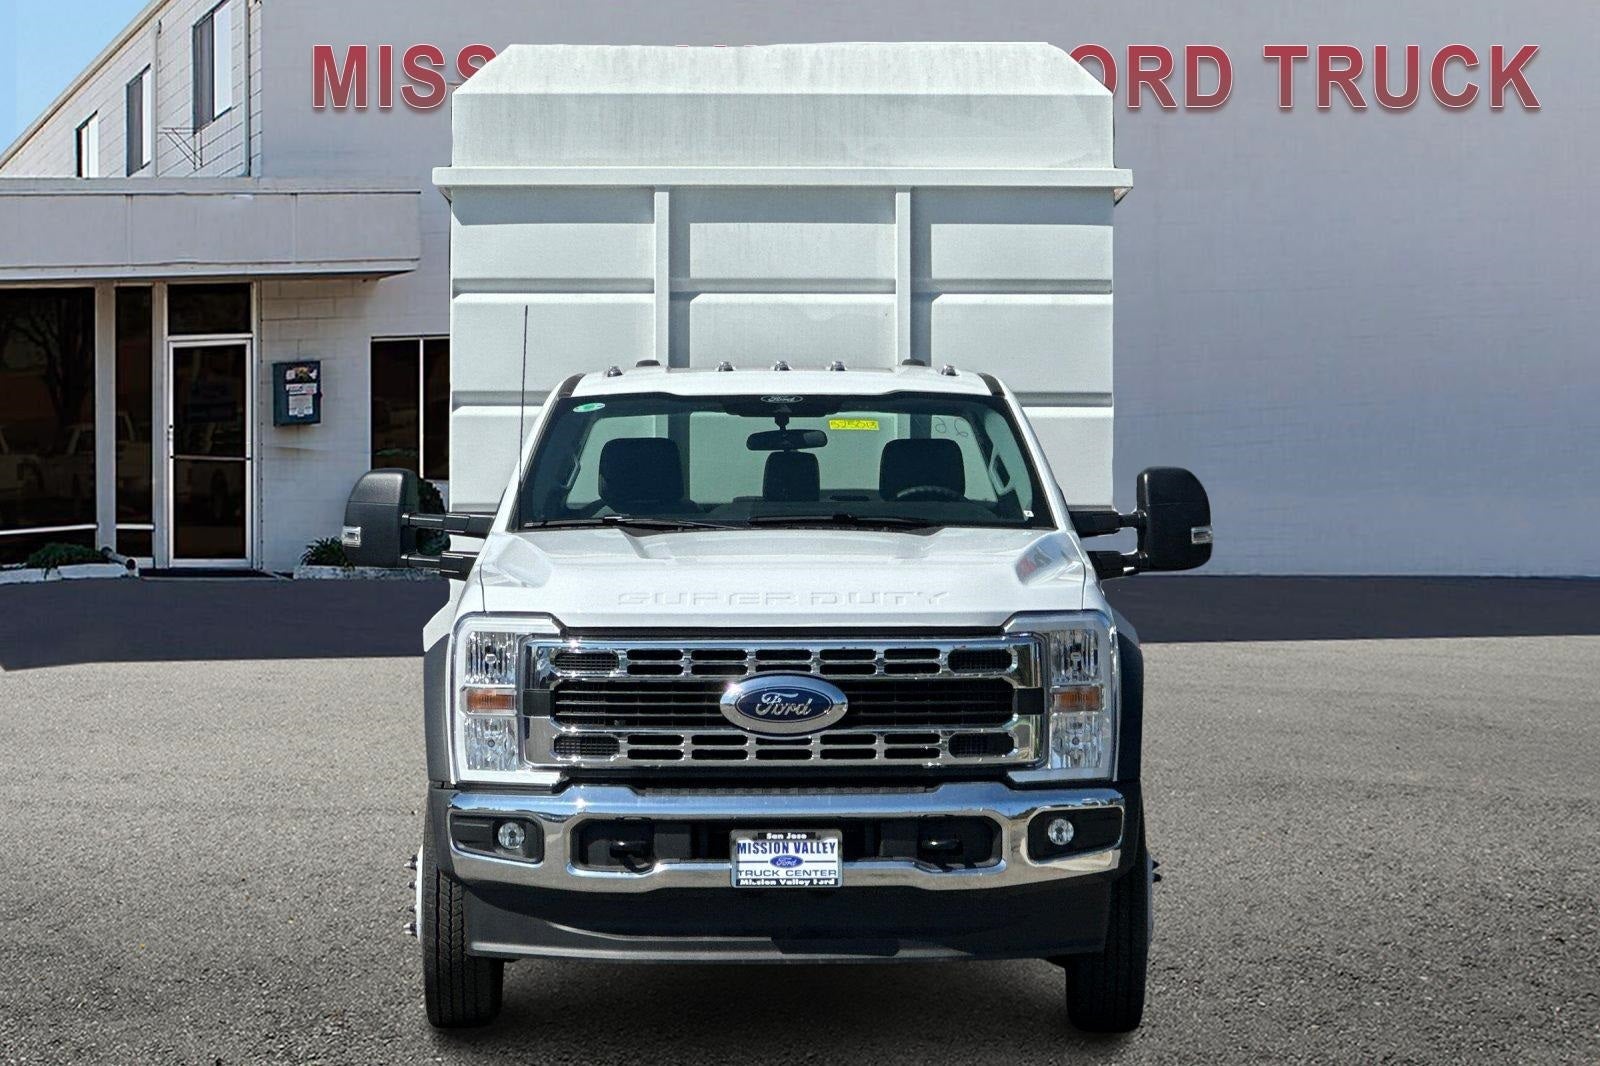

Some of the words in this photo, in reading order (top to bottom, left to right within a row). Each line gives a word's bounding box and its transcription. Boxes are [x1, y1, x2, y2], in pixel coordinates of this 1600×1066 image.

[1263, 43, 1541, 108] TRUCK
[618, 591, 800, 606] SUPER
[811, 591, 950, 606] DUTY
[755, 692, 813, 716] Ford
[737, 842, 789, 854] MISSION
[793, 842, 836, 854] VALLEY
[775, 857, 797, 867] Ford
[738, 869, 780, 877] TRUCK
[785, 869, 837, 877] CENTER
